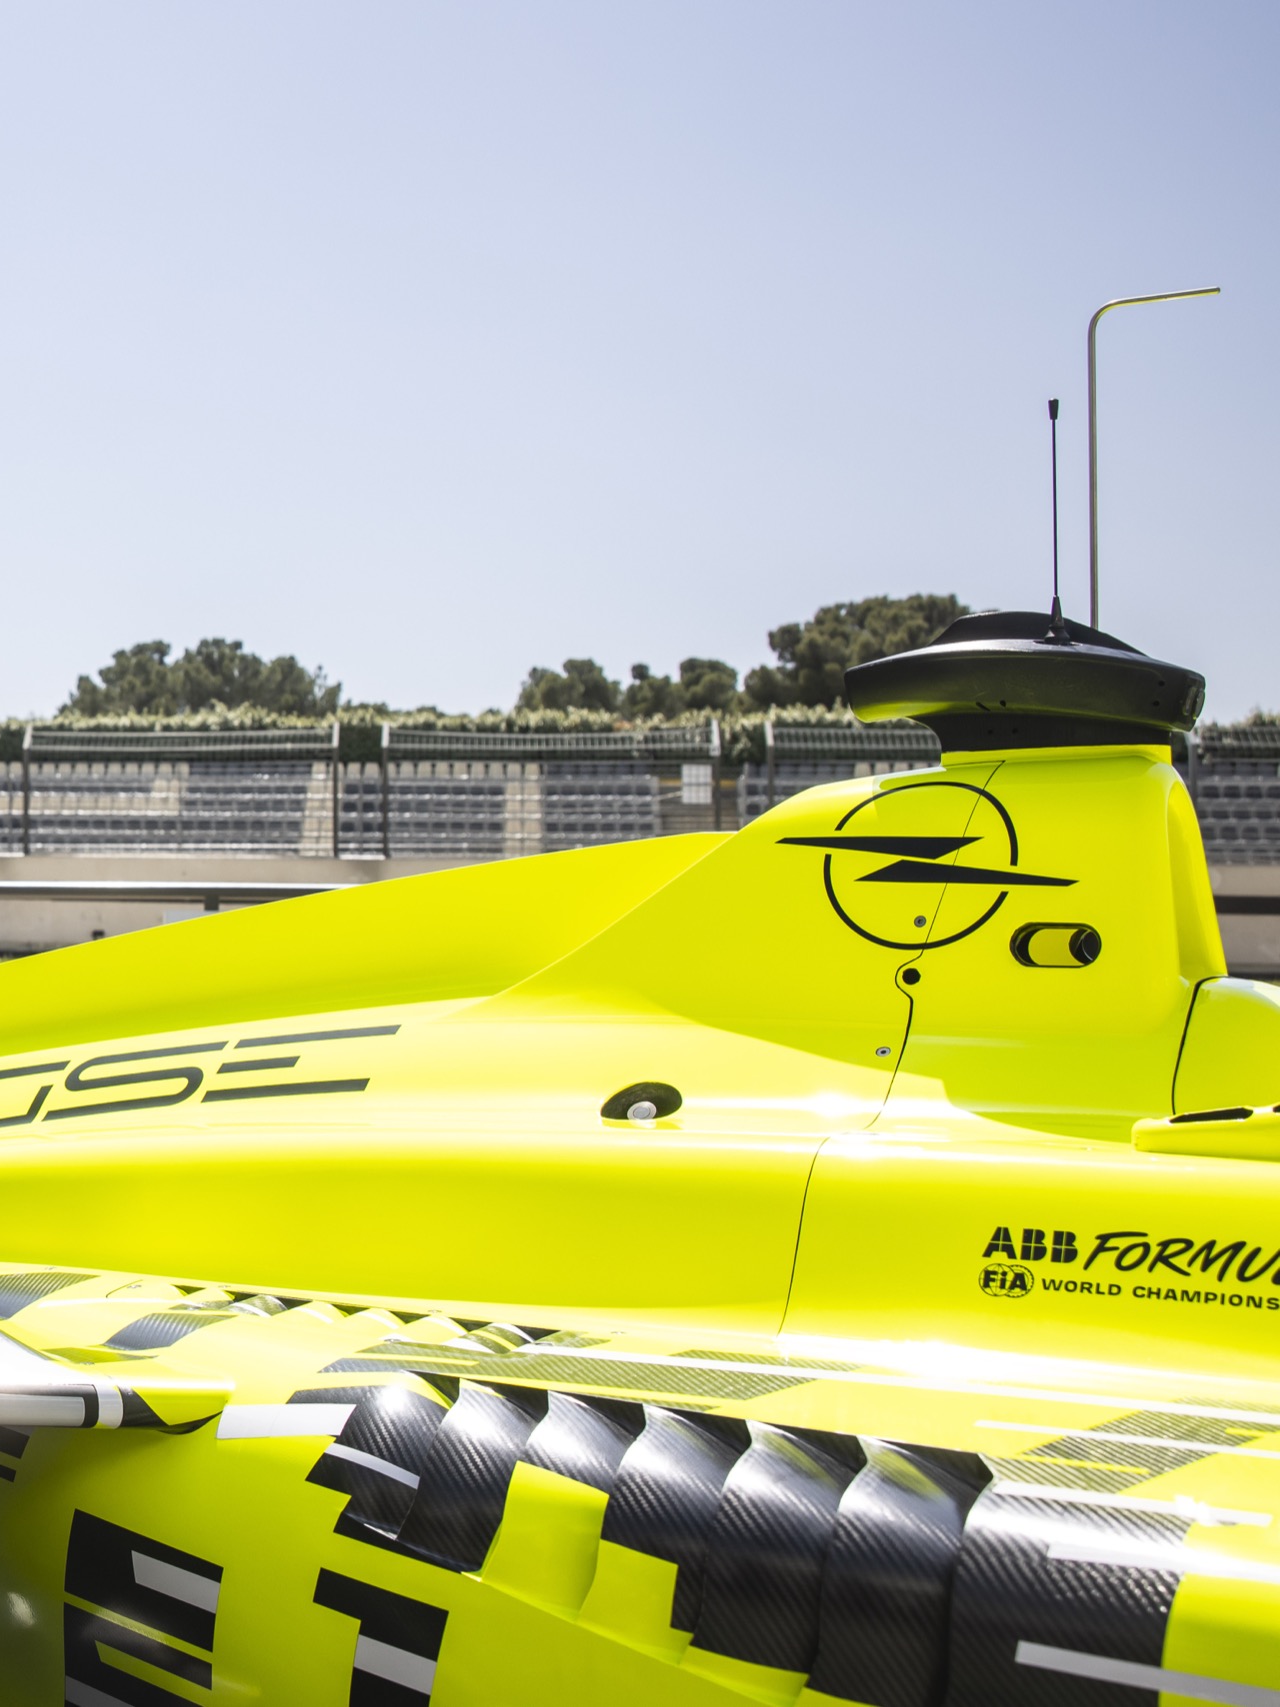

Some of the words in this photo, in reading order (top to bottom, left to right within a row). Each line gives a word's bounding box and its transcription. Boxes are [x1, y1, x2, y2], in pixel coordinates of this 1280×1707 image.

[982, 1226, 1078, 1263] ABB
[1083, 1231, 1280, 1286] FORMU
[1042, 1278, 1122, 1296] WORLD
[1132, 1286, 1280, 1310] CHAMPIONS
